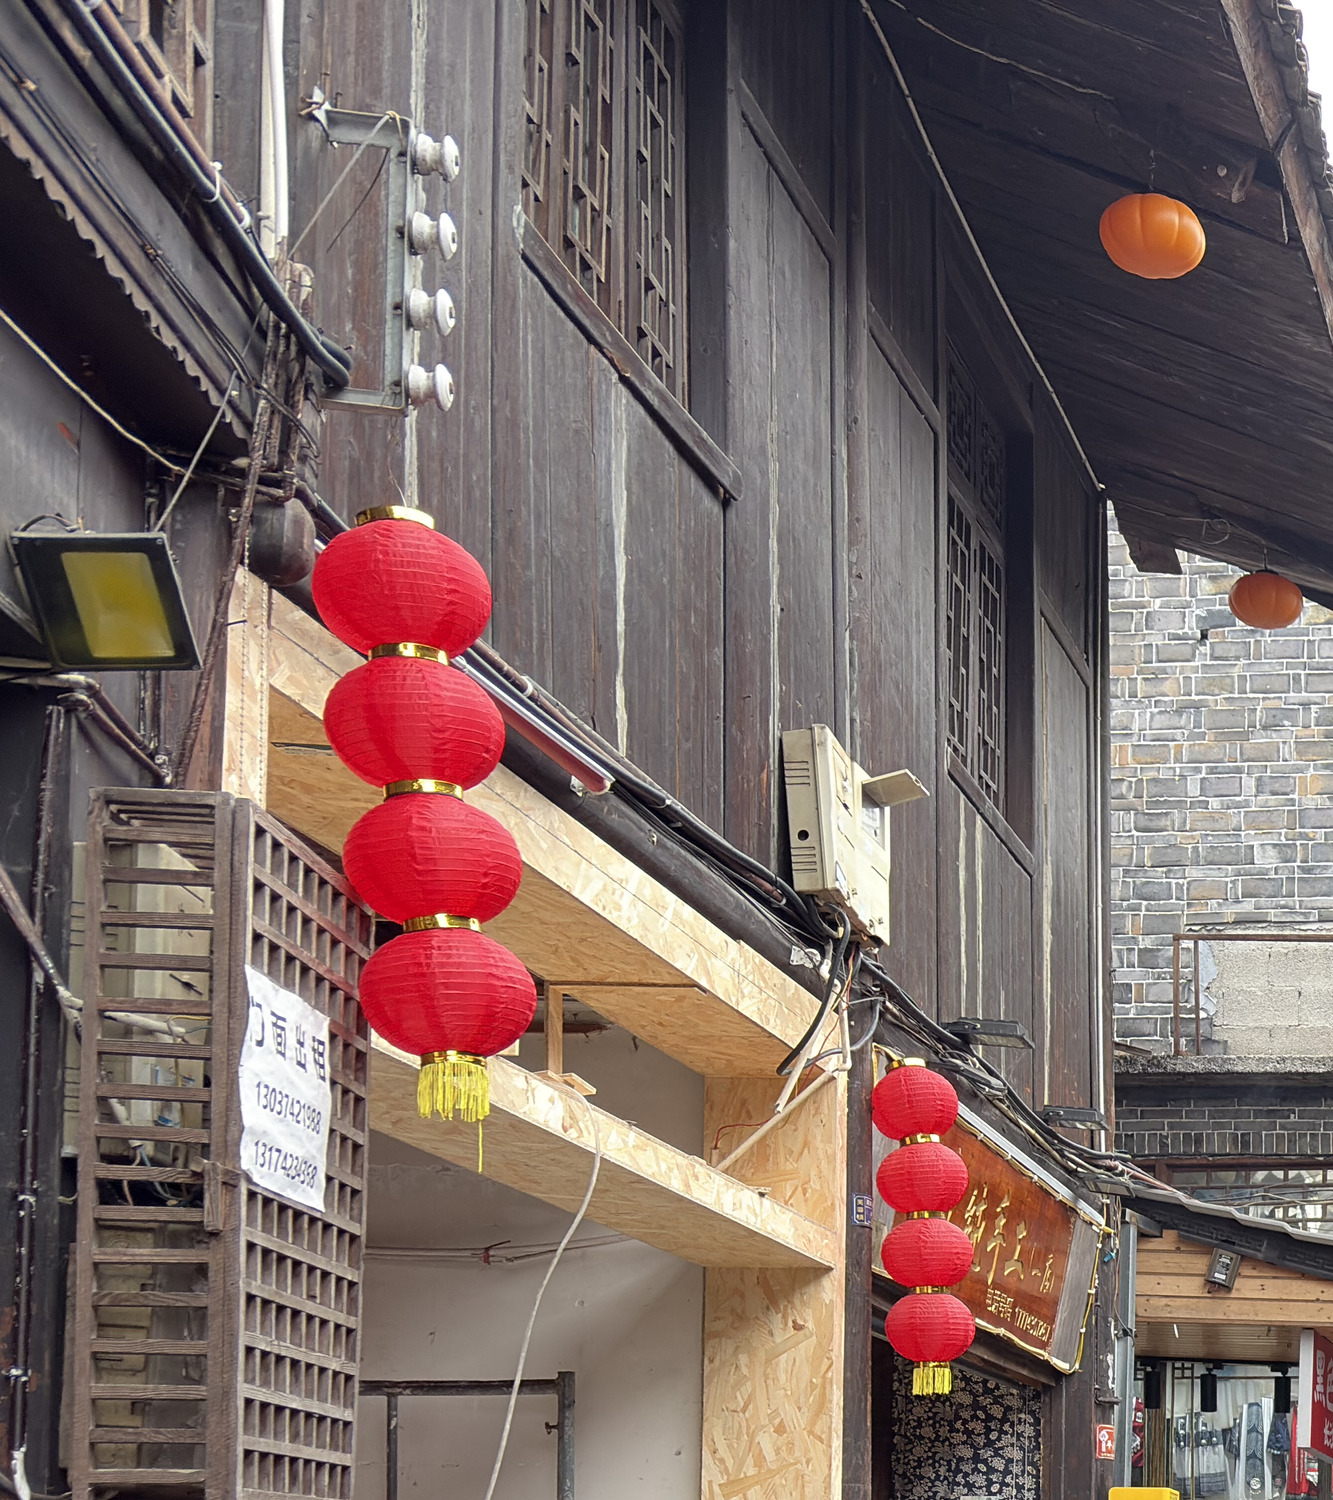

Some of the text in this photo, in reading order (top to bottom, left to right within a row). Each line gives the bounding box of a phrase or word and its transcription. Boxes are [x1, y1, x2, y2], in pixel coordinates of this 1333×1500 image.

[250, 995, 327, 1084] 门面出租
[255, 1080, 322, 1136] 13037421988
